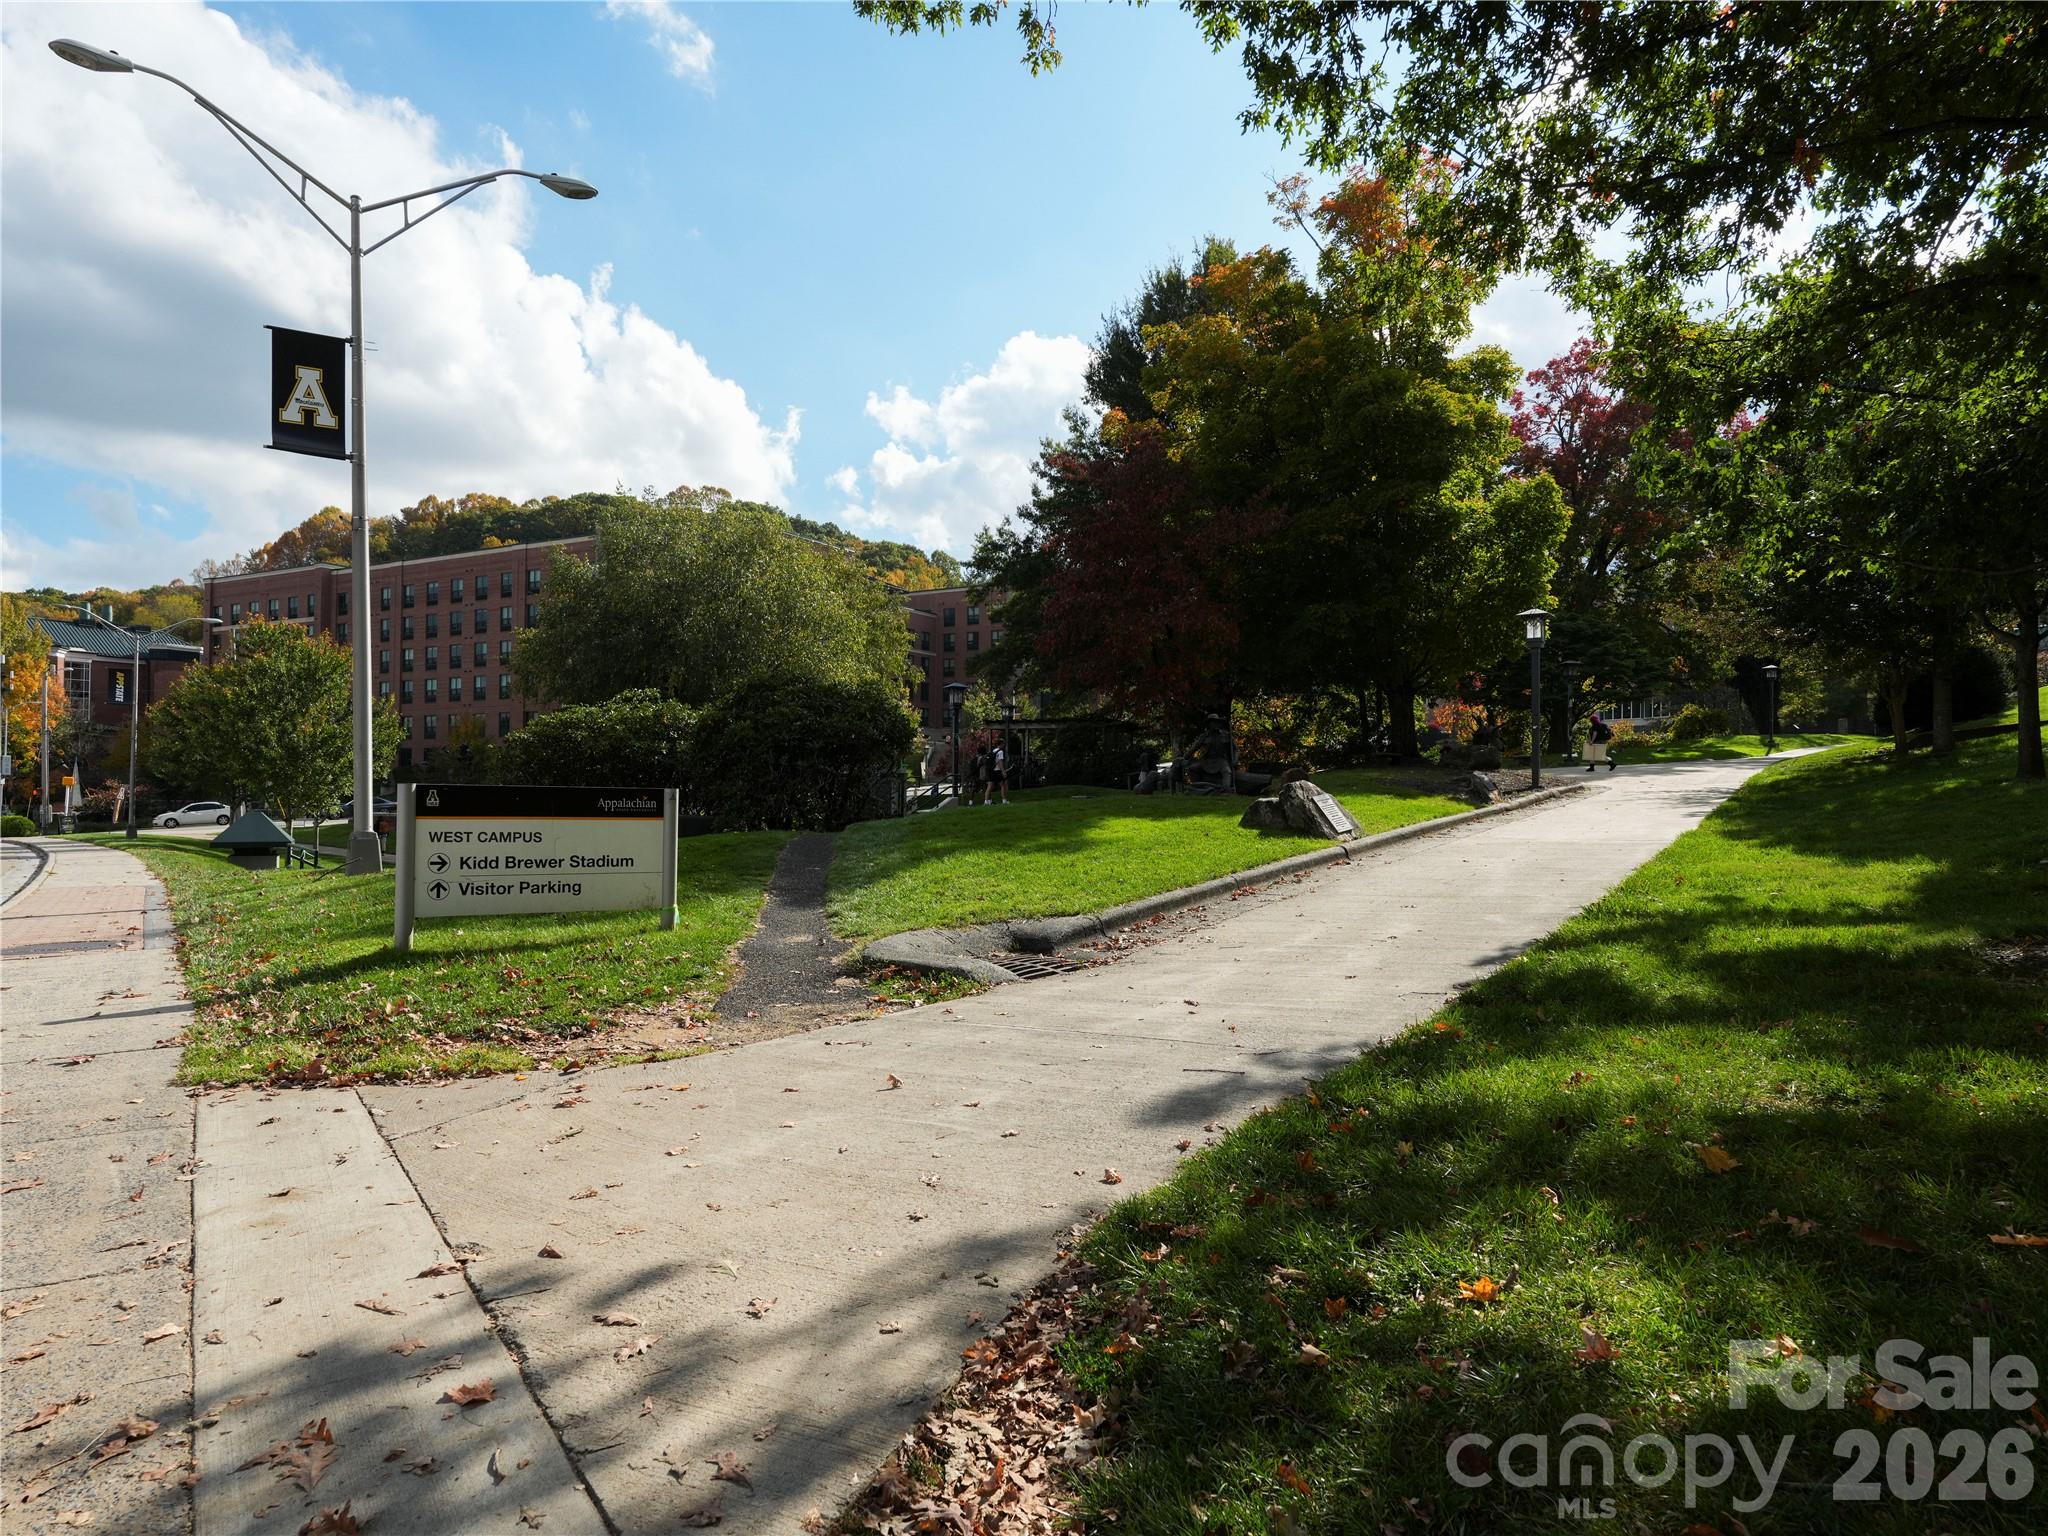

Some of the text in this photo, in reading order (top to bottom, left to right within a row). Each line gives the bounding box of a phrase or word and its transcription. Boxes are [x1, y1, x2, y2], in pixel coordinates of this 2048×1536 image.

[279, 364, 339, 430] A
[597, 797, 657, 812] Appalachian
[428, 831, 543, 843] WEST CAMPUS
[459, 854, 635, 870] Kidd Brewer Stadium
[458, 880, 582, 896] Visitor Parking
